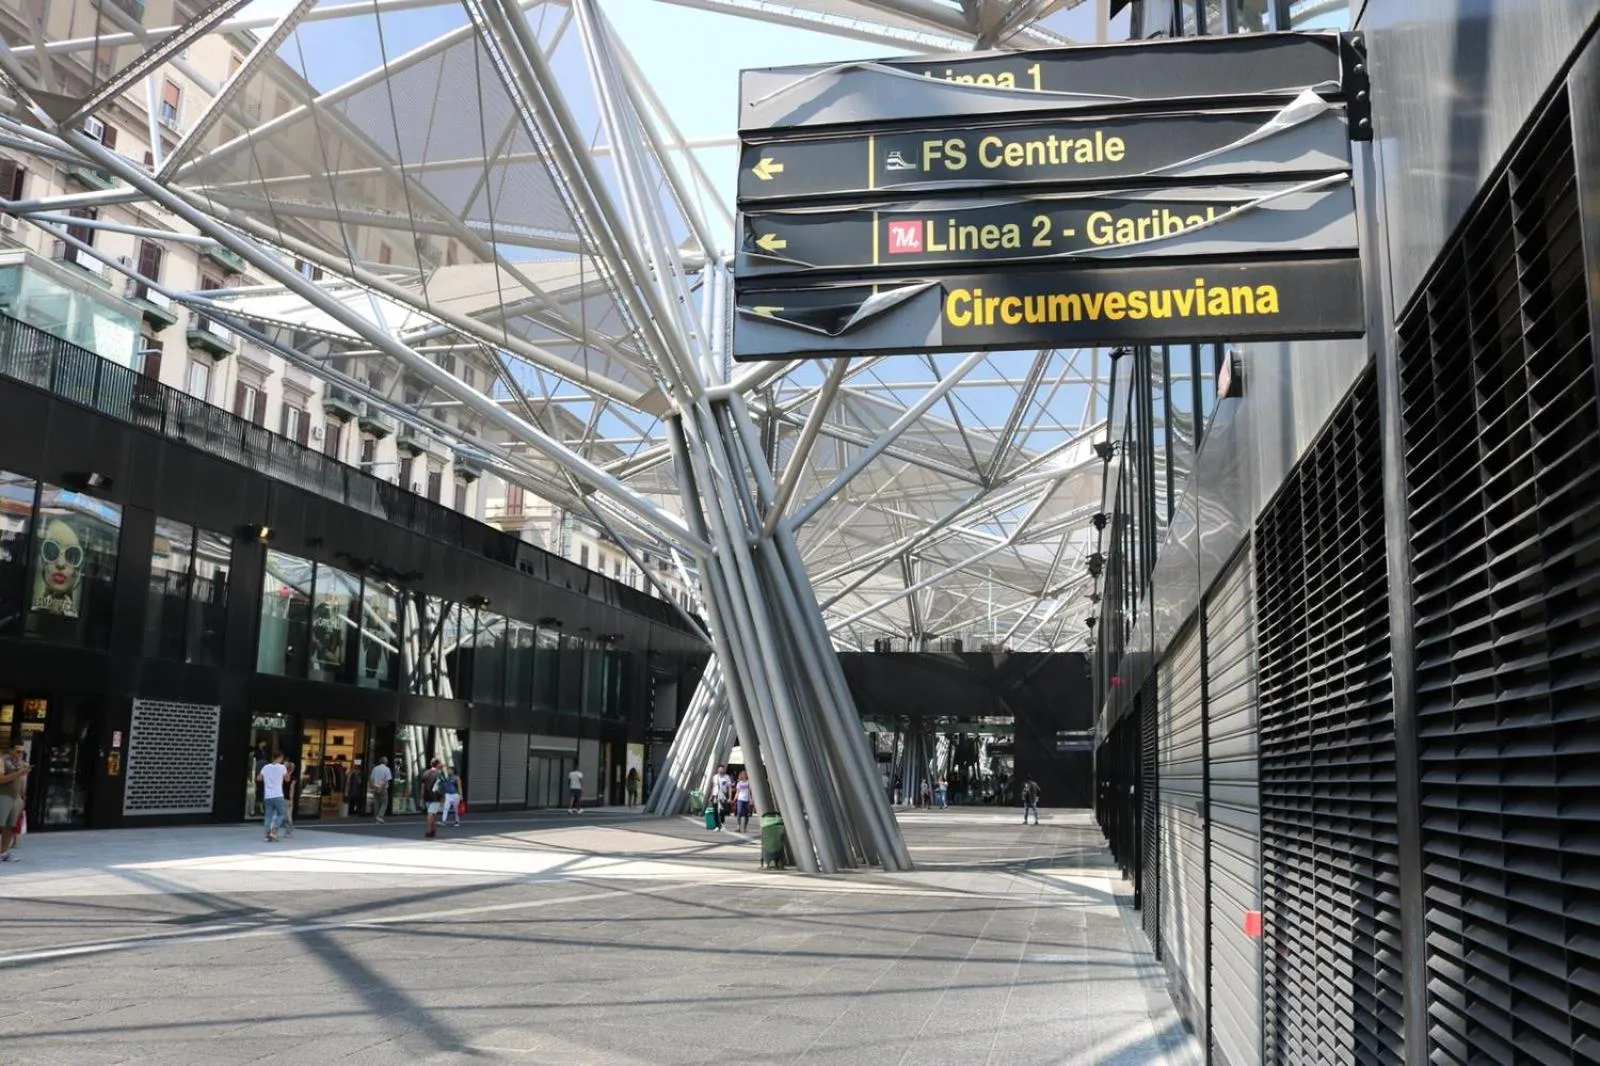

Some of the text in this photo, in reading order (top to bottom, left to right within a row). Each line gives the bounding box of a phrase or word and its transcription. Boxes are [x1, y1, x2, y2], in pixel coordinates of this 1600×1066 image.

[1028, 63, 1041, 91] 1
[923, 131, 1126, 172] FS Centrale
[926, 218, 1022, 252] Linea
[1032, 214, 1053, 247] 2
[946, 278, 1280, 328] Circumvesuviana
